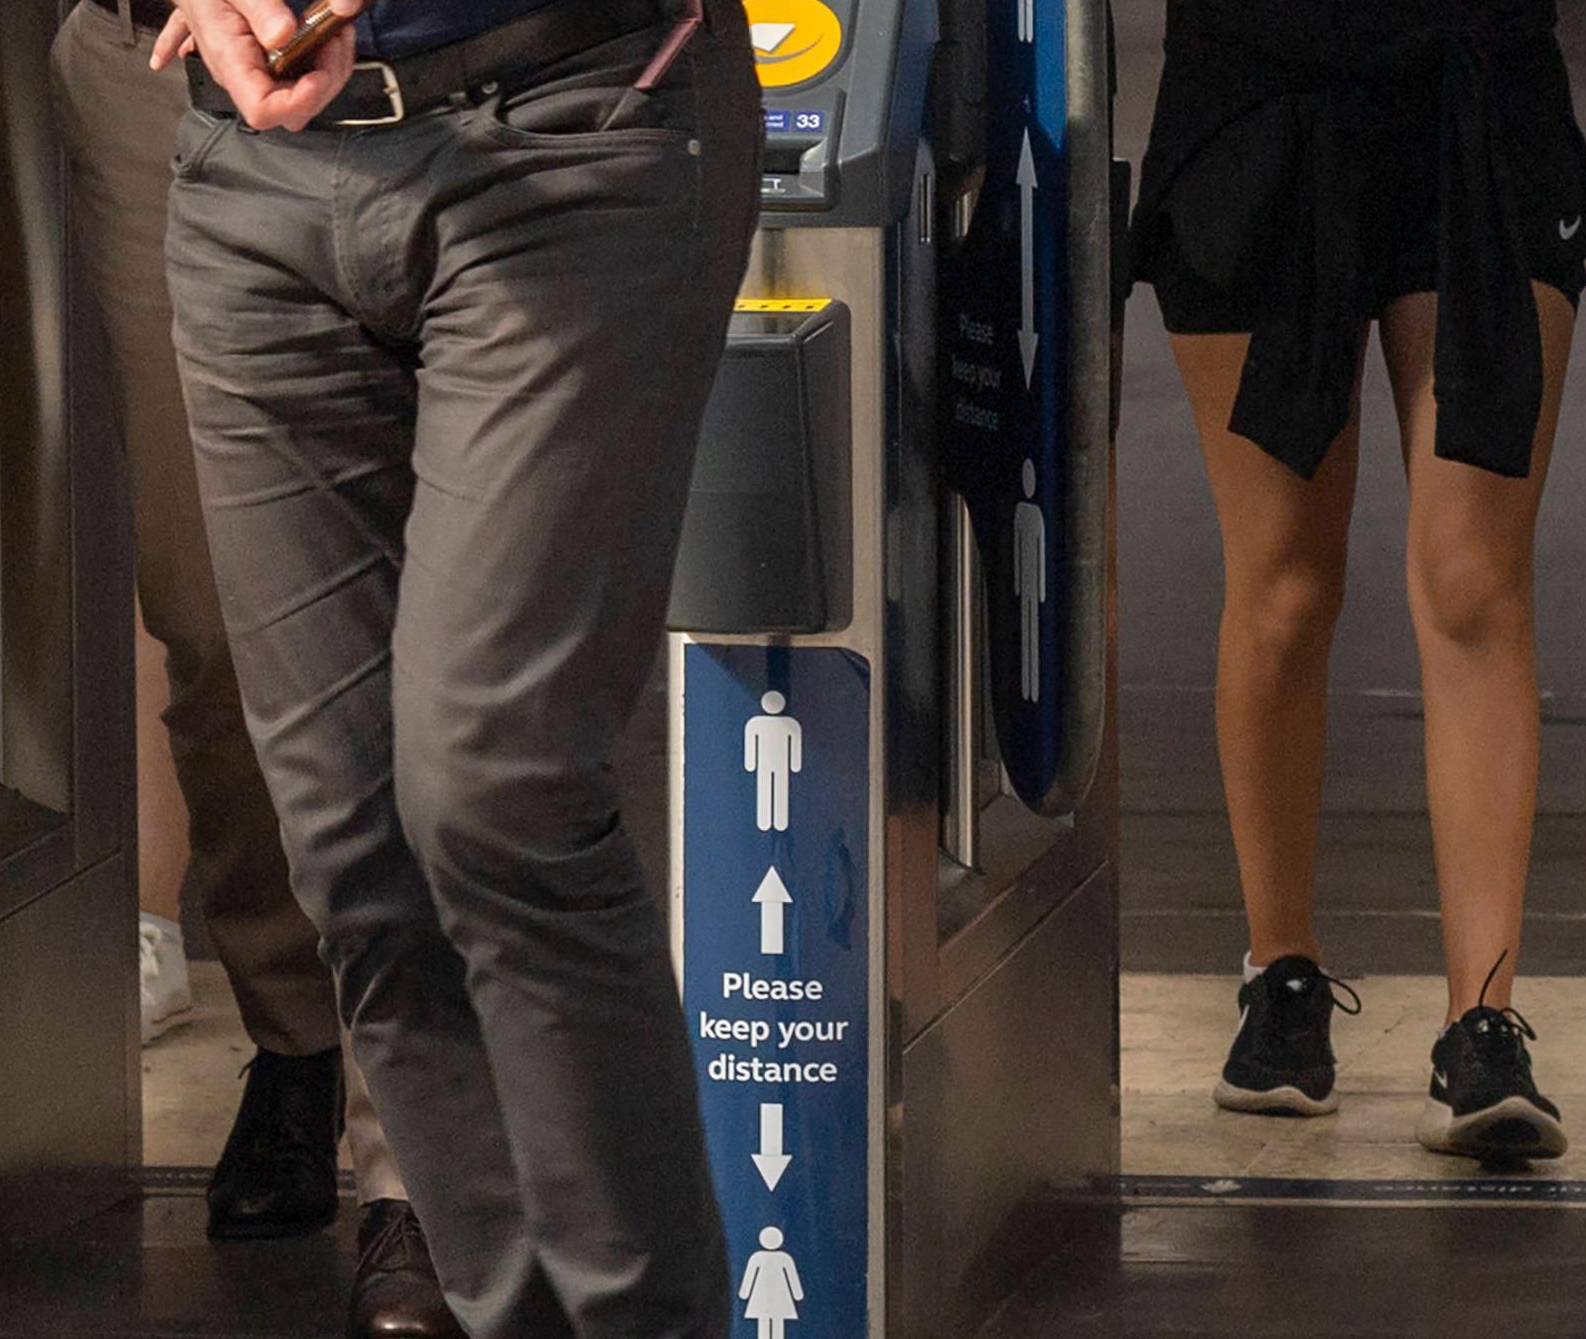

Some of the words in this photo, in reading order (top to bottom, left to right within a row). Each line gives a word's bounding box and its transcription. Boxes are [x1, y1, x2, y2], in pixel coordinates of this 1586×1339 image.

[796, 114, 821, 129] 33
[723, 973, 823, 1000] Please
[700, 1012, 769, 1047] keep
[778, 1021, 849, 1048] your
[708, 1054, 837, 1082] distance
